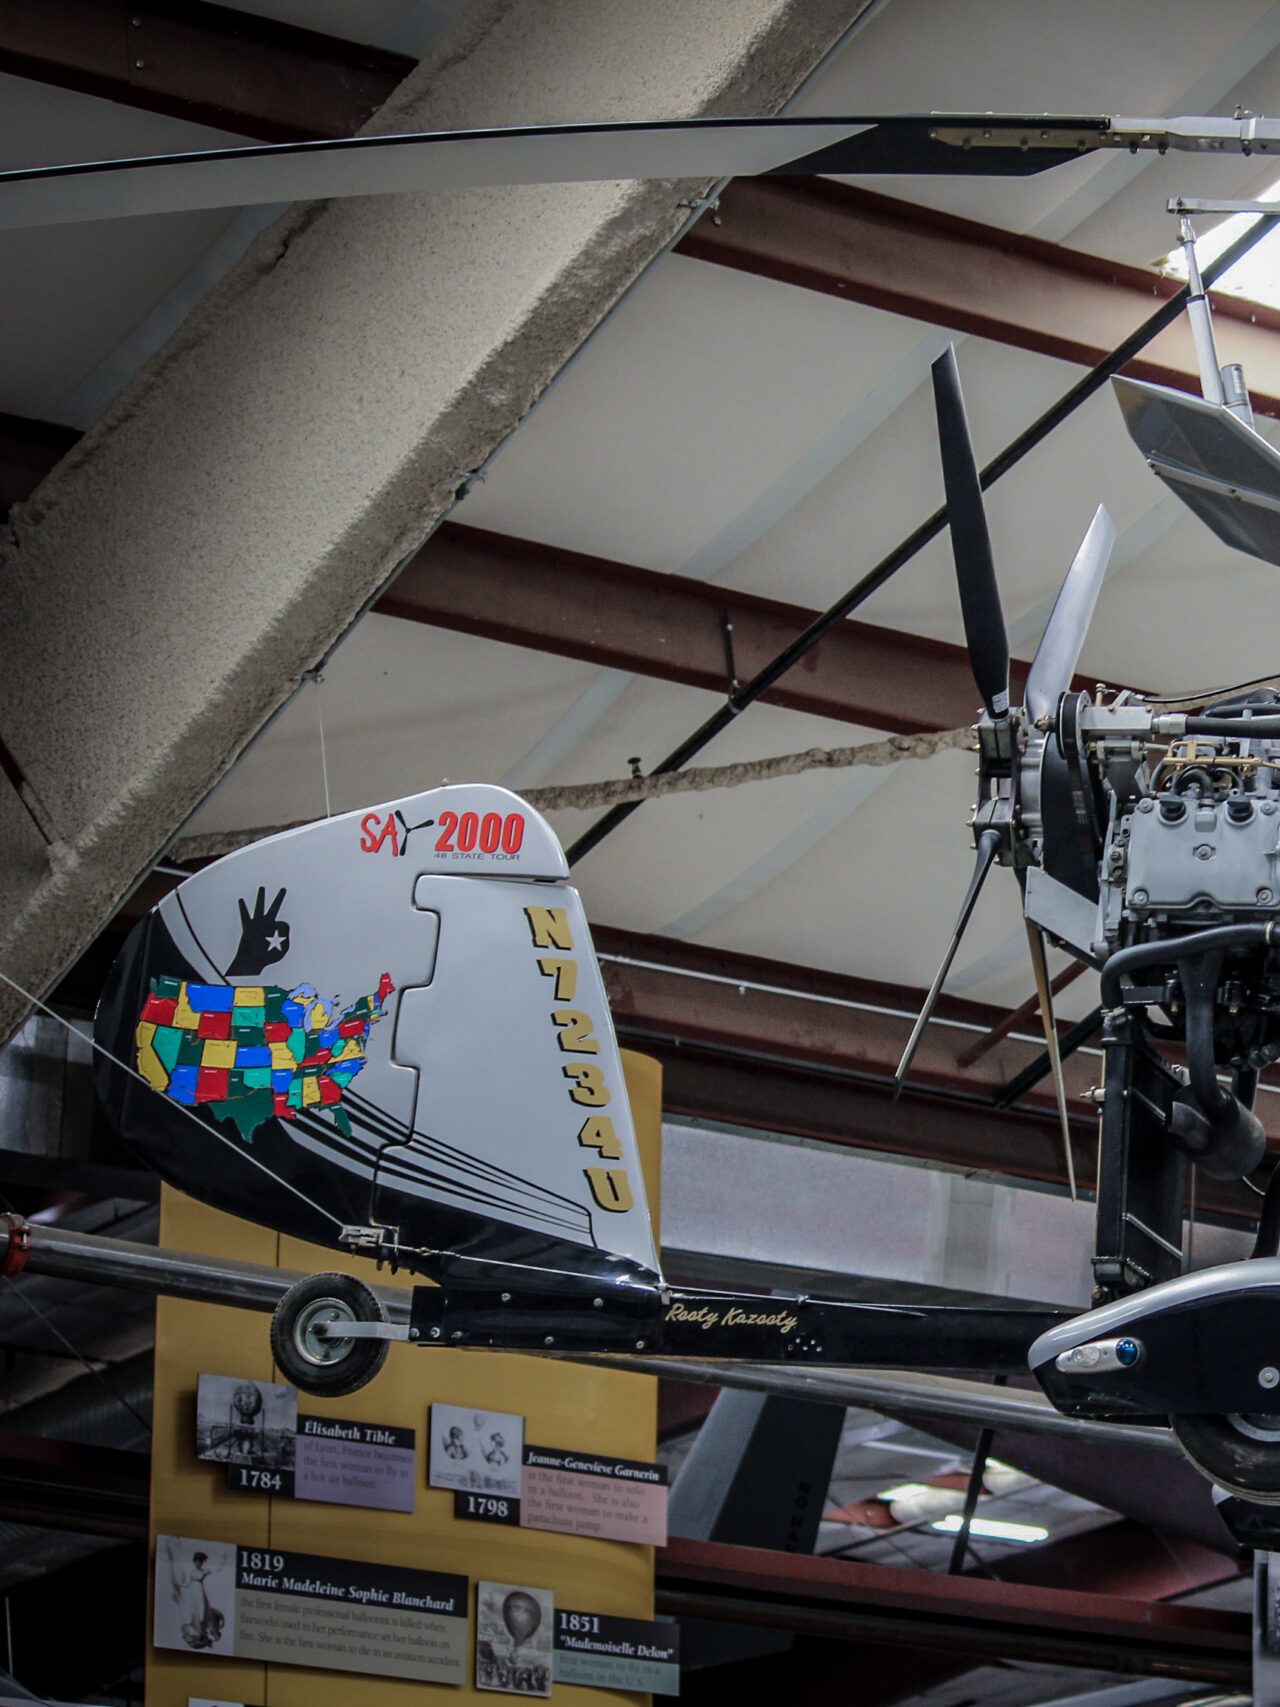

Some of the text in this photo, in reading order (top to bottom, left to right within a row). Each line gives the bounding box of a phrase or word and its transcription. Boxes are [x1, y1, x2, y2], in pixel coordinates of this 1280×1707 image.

[434, 811, 525, 855] 2000
[452, 852, 484, 861] STATE
[490, 853, 520, 861] TOUR
[523, 905, 635, 1213] N7234U
[665, 1303, 798, 1334] Rooty Kazooty
[364, 1427, 395, 1444] Tible
[239, 1468, 281, 1489] 1784
[614, 1464, 659, 1481] Garnerin
[467, 1495, 508, 1517] 1798
[241, 1550, 283, 1572] 1819
[241, 1571, 454, 1611] Marie Madeleine Sophie Blanchard
[560, 1612, 599, 1634] 1851
[560, 1635, 673, 1658] "Mademoiselle Delon"
